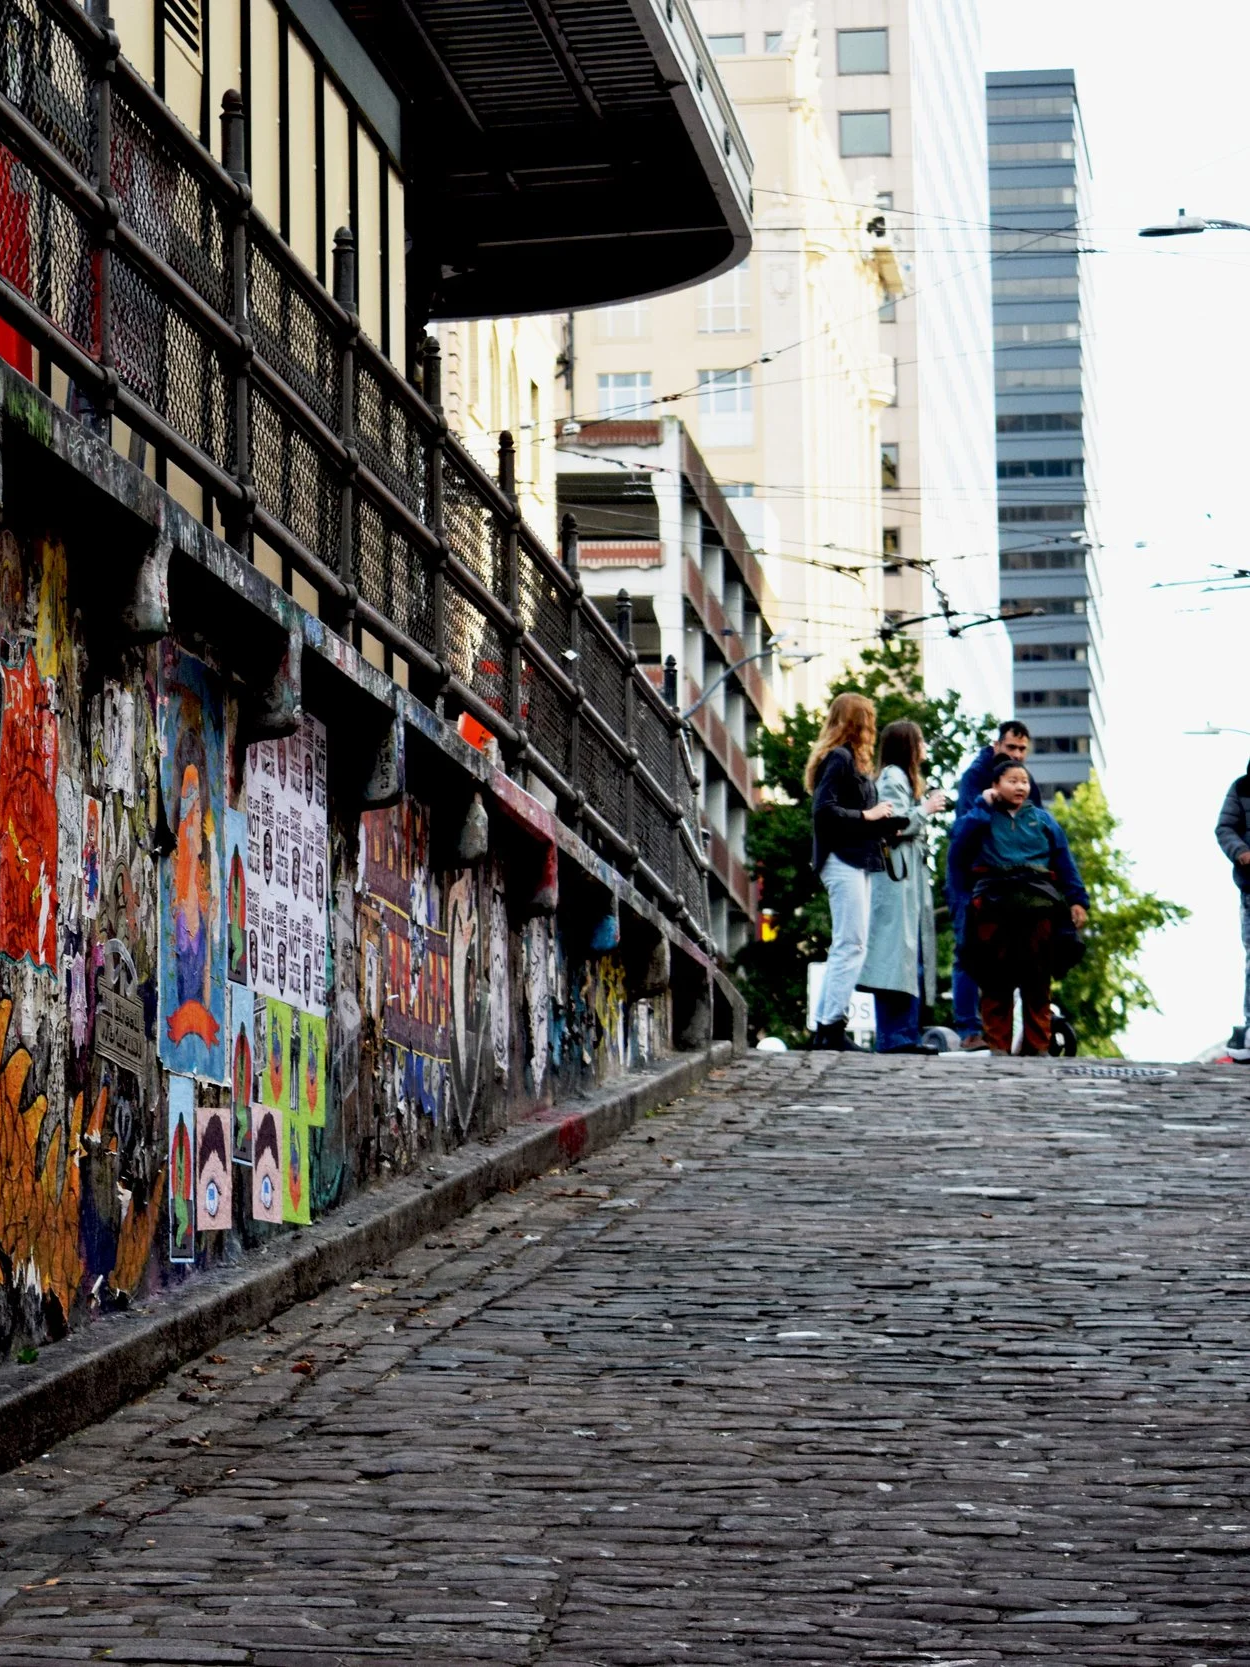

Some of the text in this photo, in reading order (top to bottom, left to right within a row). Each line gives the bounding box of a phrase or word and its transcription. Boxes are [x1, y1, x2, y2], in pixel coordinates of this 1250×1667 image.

[275, 825, 289, 854] NOT
[261, 920, 275, 951] NOT
[288, 931, 301, 961] NOT
